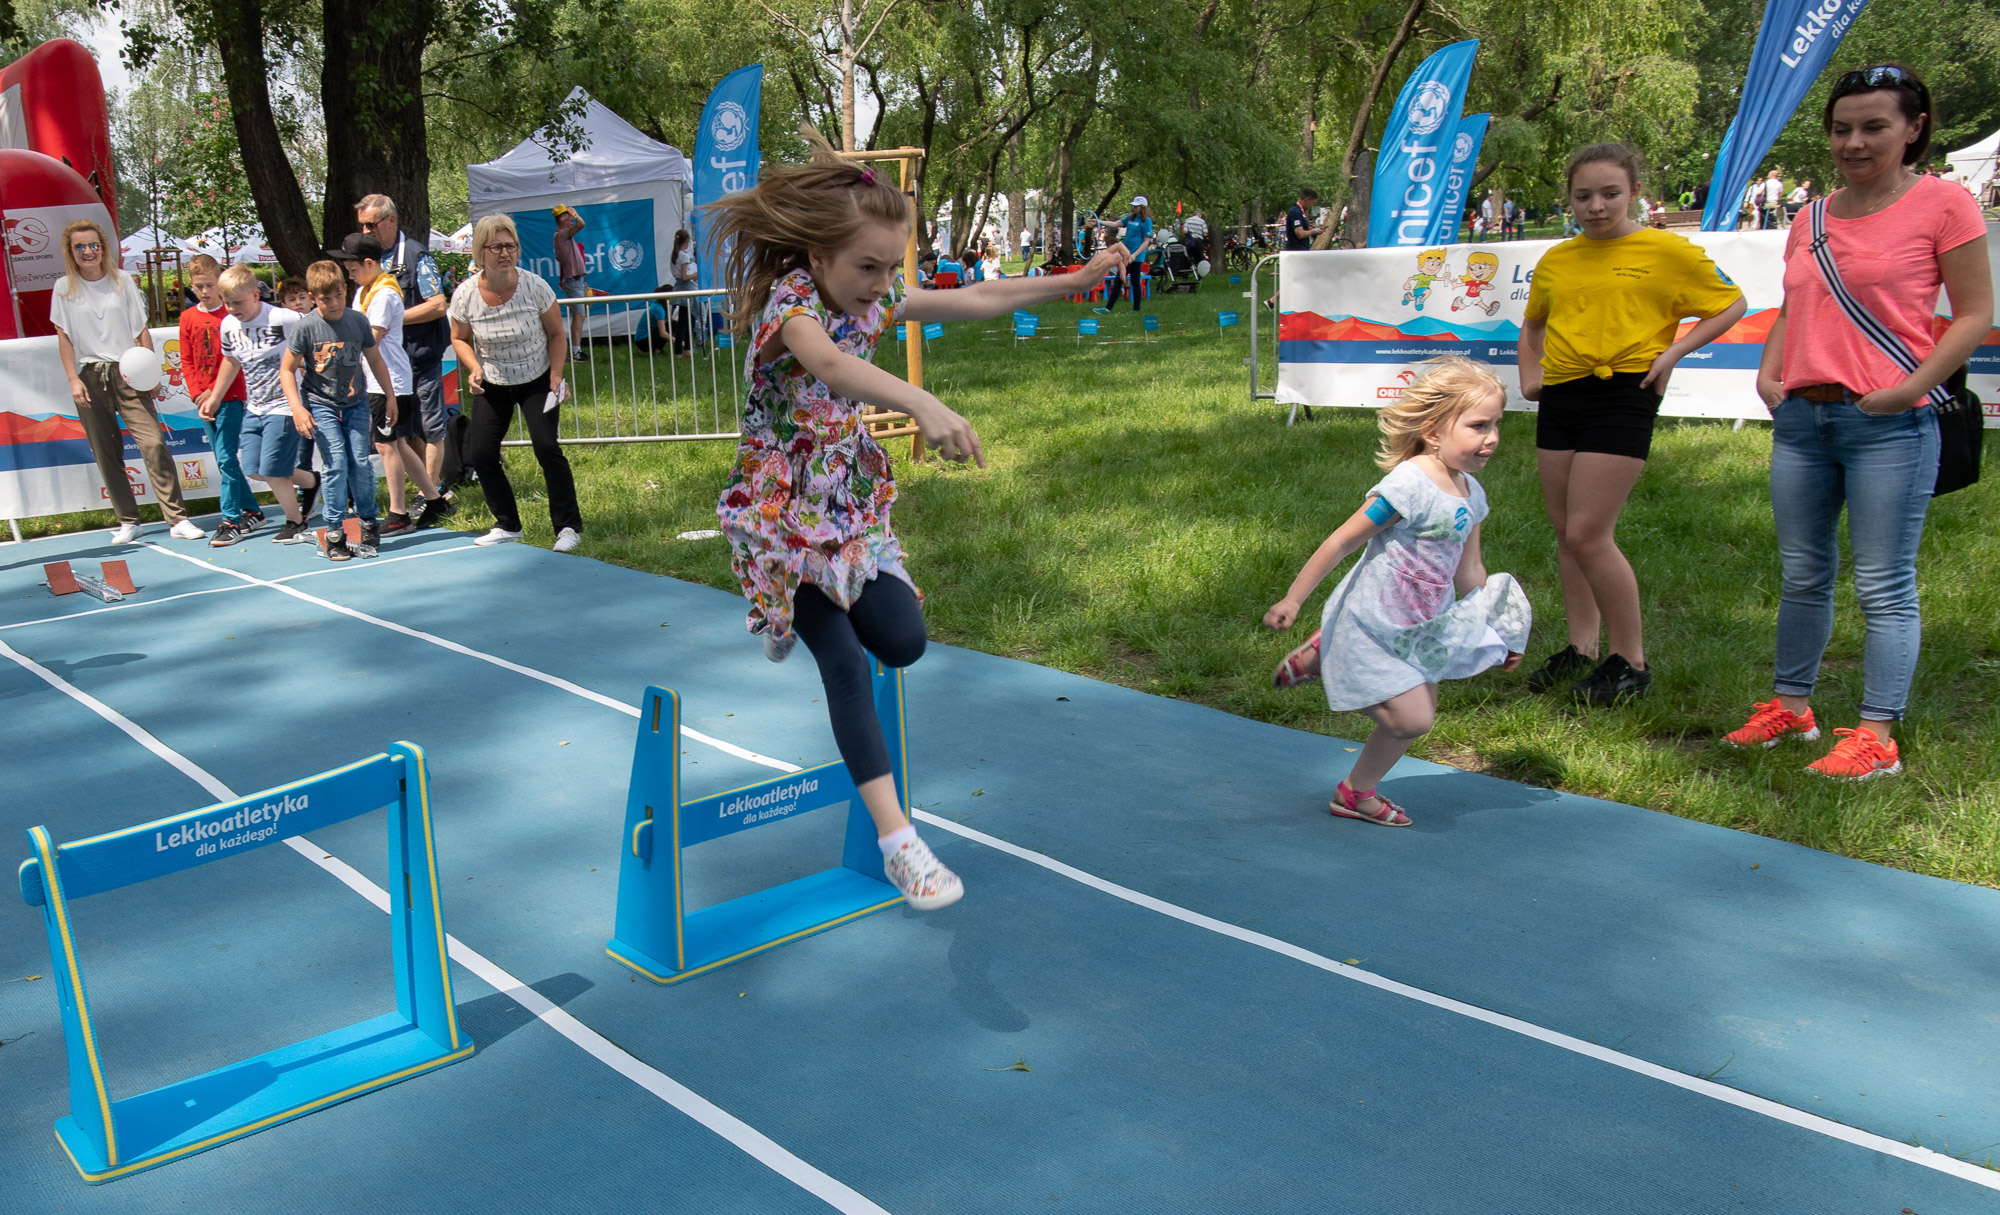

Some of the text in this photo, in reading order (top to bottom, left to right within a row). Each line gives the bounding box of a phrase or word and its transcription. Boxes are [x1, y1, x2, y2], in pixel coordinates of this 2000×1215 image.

[1780, 0, 1841, 69] Lekko
[1831, 0, 1861, 39] dla ka
[1391, 139, 1437, 244] nicef
[518, 243, 605, 277] unief
[1511, 264, 1535, 284] Le
[1378, 388, 1404, 398] ORL
[719, 778, 819, 818] Lekkoatletyka
[743, 800, 797, 825] dla każdego!
[155, 794, 309, 852] Lekkoatletyka
[195, 822, 278, 858] dla każdego!
